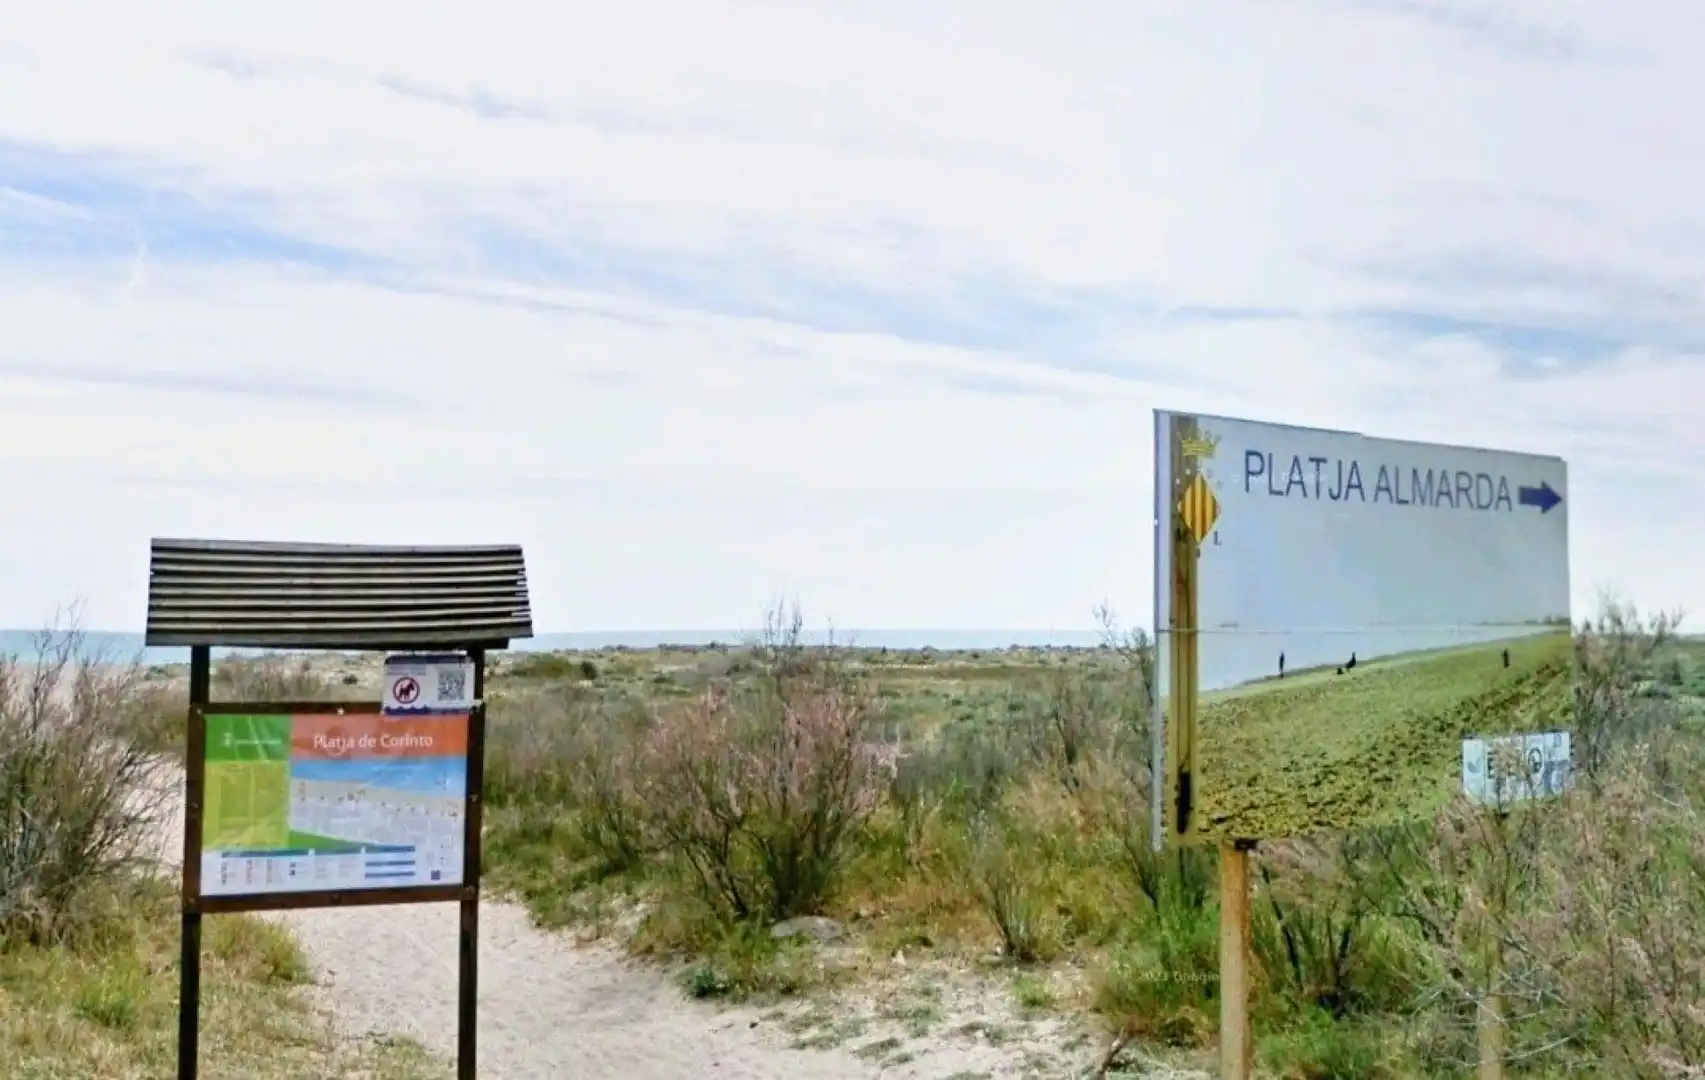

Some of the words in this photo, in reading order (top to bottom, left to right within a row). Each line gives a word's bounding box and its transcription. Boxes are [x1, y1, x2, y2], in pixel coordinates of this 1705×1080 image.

[1244, 449, 1366, 502] PLATJA
[1373, 463, 1513, 513] ALMARDA
[313, 732, 355, 752] Platja
[358, 733, 377, 748] de
[380, 733, 434, 748] Corinto
